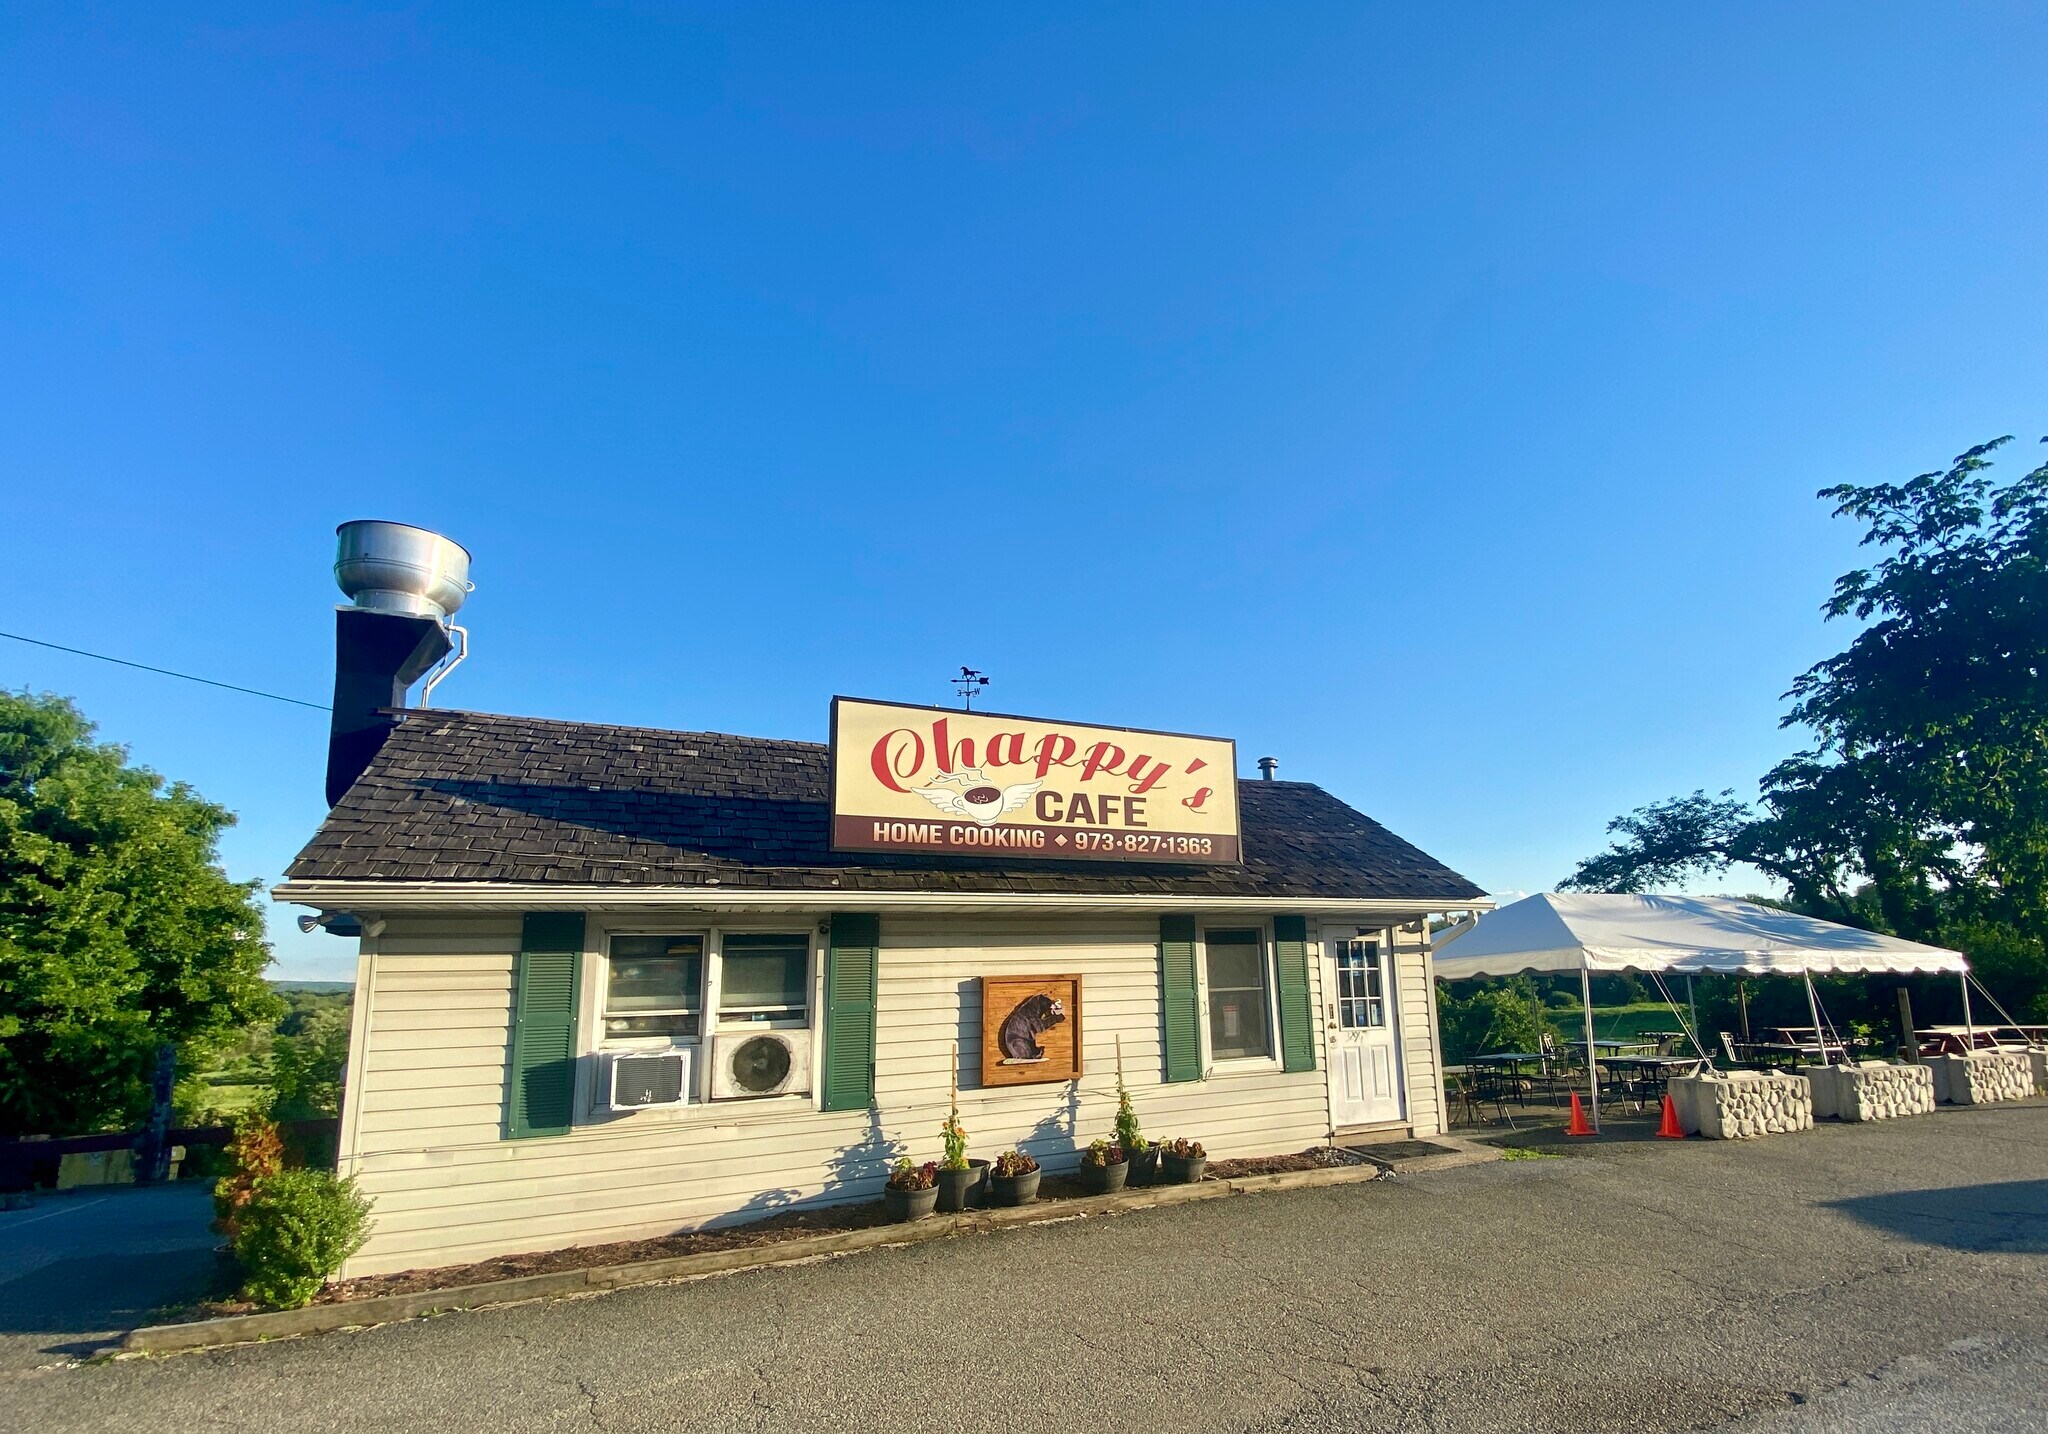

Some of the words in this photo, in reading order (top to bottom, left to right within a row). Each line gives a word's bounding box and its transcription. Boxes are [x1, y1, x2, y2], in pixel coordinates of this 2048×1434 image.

[1036, 790, 1148, 827] CAFE
[873, 822, 943, 844] HOME
[950, 826, 1045, 848] COOKING
